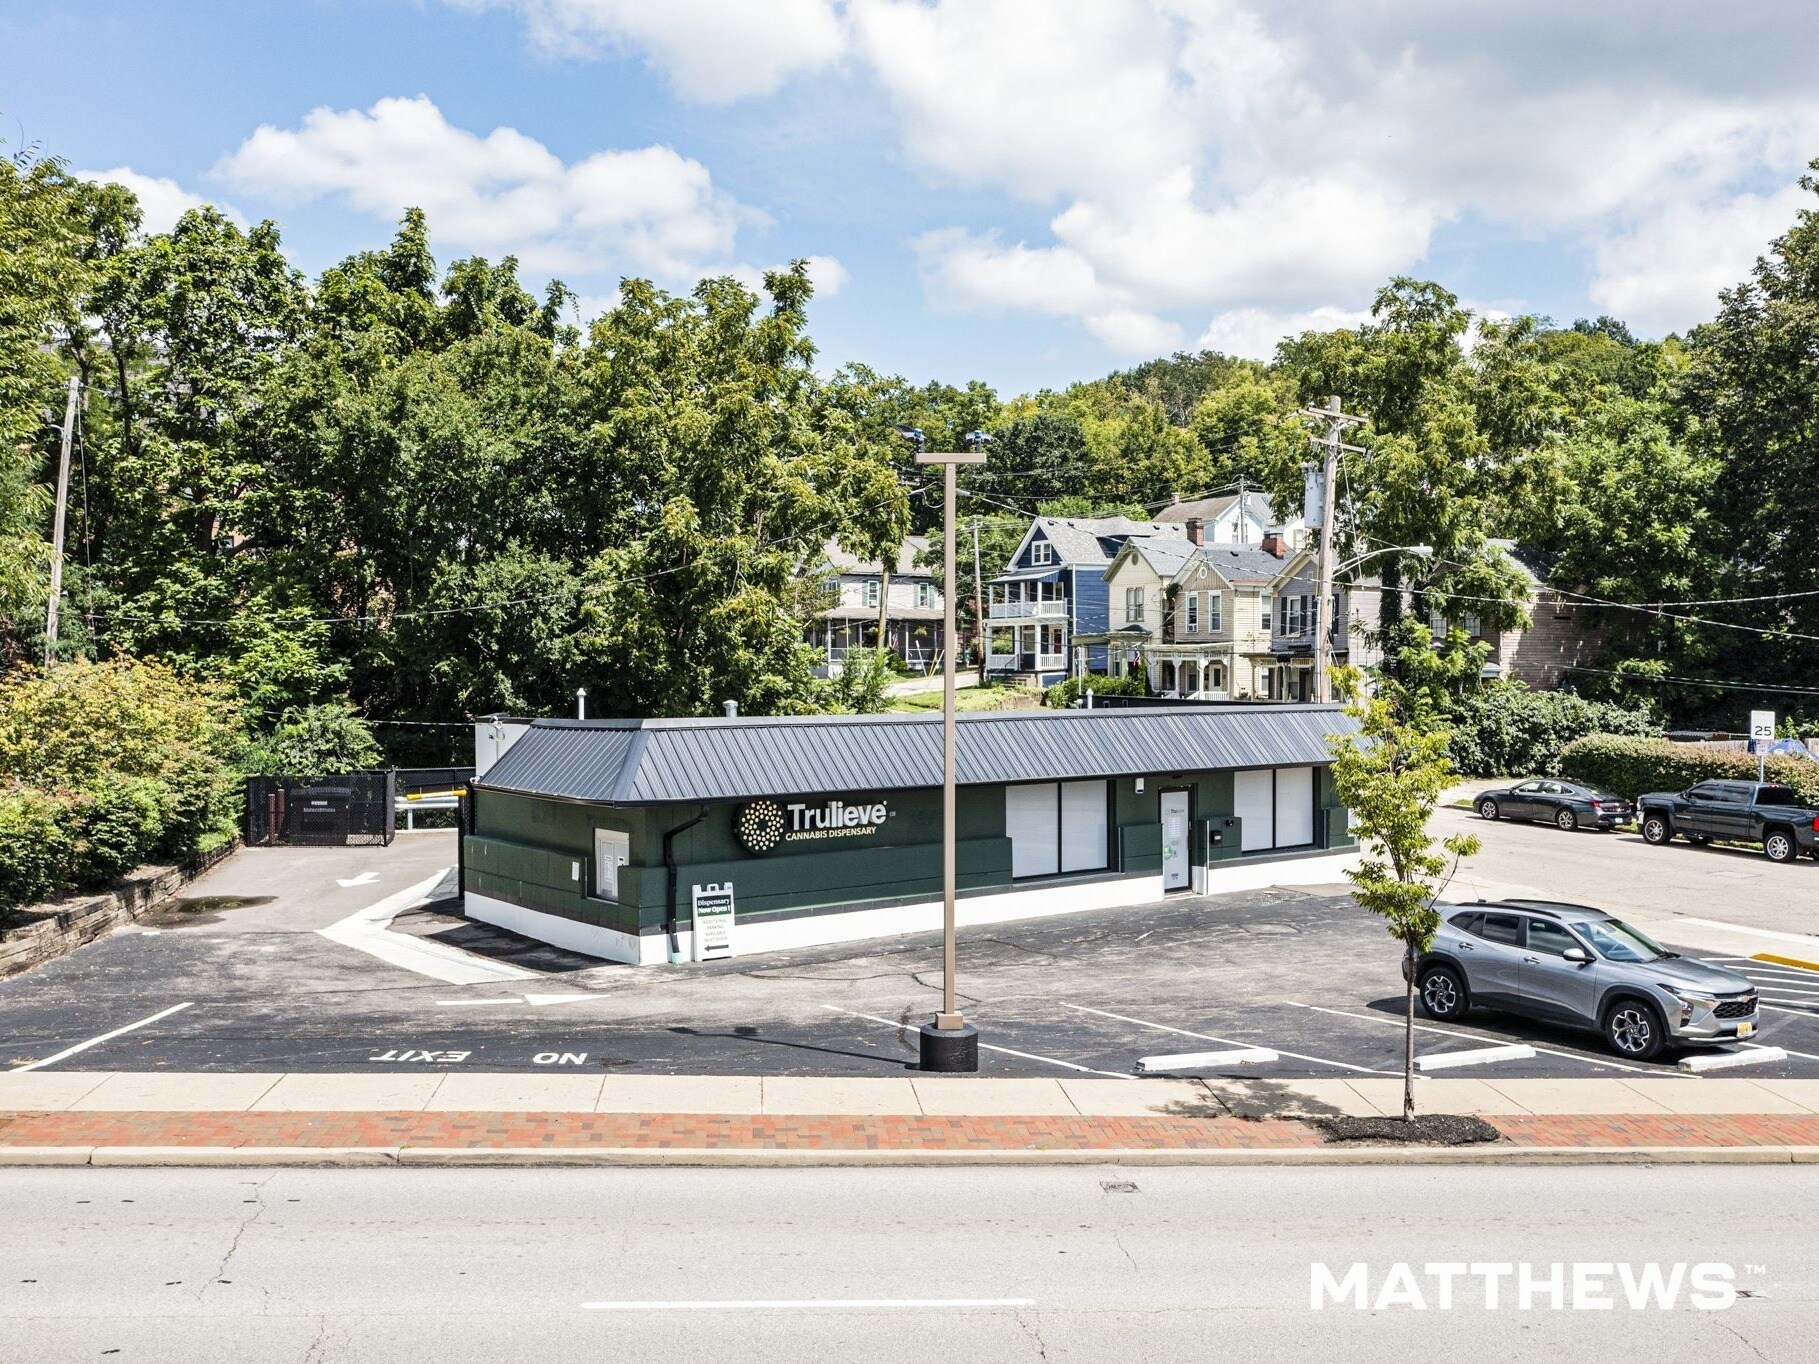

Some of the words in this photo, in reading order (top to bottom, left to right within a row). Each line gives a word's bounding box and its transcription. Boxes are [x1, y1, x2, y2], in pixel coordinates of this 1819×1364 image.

[1755, 726, 1772, 736] 25
[787, 801, 887, 830] Trulieve
[785, 830, 828, 841] CANNABIS
[829, 826, 877, 838] DISPENSARY
[368, 1050, 472, 1062] EXIT
[532, 1052, 588, 1064] NO
